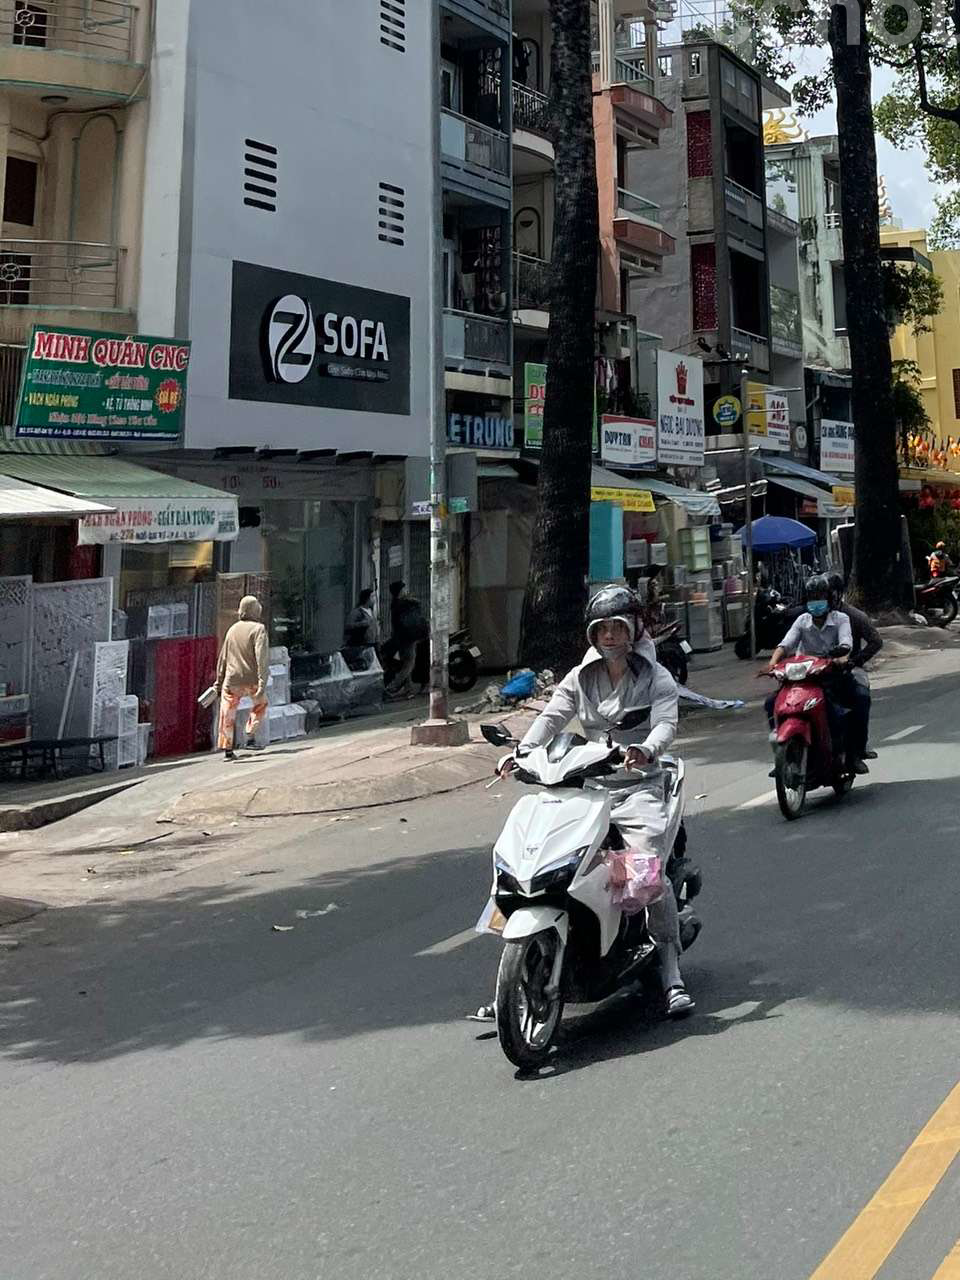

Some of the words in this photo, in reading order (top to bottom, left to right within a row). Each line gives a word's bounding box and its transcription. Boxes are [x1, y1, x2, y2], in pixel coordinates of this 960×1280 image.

[32, 331, 92, 363] MINH
[149, 344, 189, 371] CNC
[324, 312, 389, 361] SOFA
[463, 415, 514, 447] TRUNG
